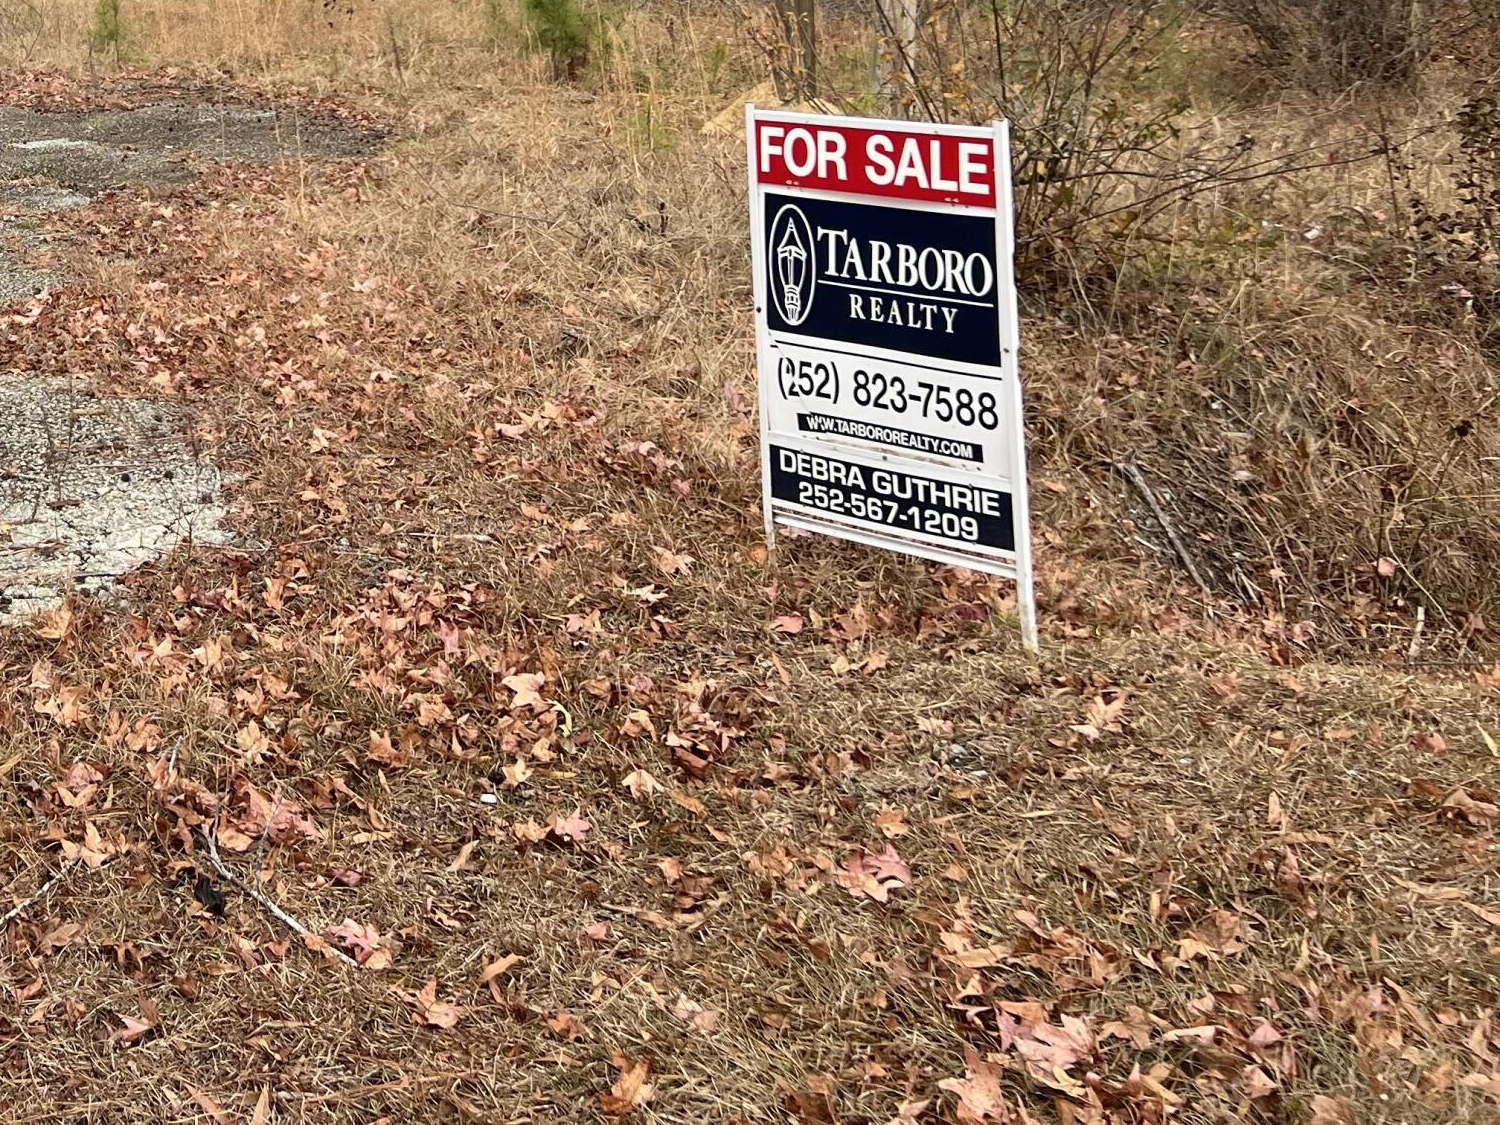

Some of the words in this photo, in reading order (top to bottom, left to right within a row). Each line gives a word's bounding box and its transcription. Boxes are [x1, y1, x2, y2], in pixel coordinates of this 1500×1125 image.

[759, 125, 849, 181] FOR
[864, 133, 990, 196] SALE
[817, 226, 994, 298] TARBORO
[849, 293, 959, 334] REALTY
[778, 357, 840, 405] (252)
[853, 369, 999, 431] 823-7588
[779, 449, 867, 491] DEBRA
[872, 471, 1001, 517] GUTHRIE
[798, 481, 979, 541] 252-567-1209
